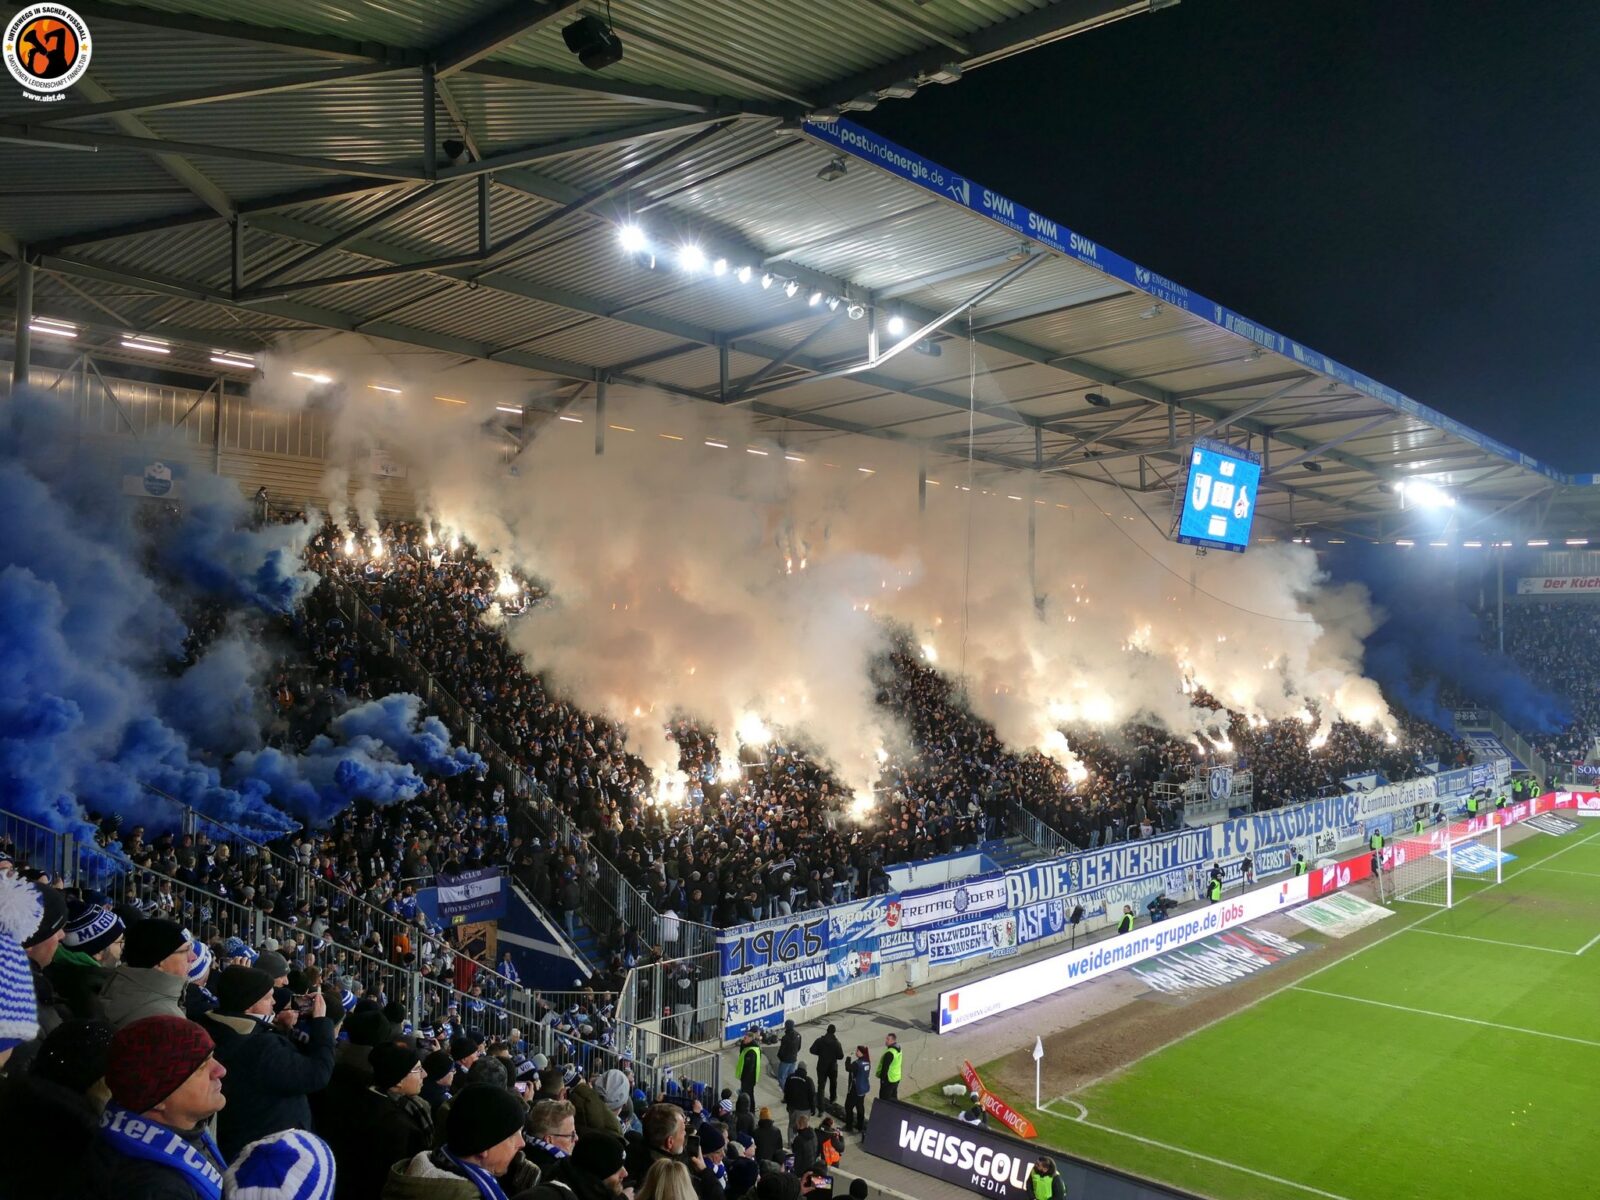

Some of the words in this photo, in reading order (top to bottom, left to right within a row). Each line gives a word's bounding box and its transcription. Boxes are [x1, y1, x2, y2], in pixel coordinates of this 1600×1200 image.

[983, 190, 1015, 220] SWM
[1028, 212, 1058, 241] SWM
[1070, 233, 1097, 260] SWM
[1543, 579, 1567, 589] Der
[1252, 795, 1355, 850] MAGDEBURG
[1006, 862, 1068, 910] BLUE
[1081, 833, 1204, 889] GENERATION
[1262, 849, 1286, 870] ZERBST
[901, 899, 953, 918] FREITAG
[969, 890, 994, 904] DER
[929, 924, 981, 944] SALZWEDEL
[1018, 903, 1047, 943] ASP
[730, 918, 824, 975] 1965
[880, 931, 915, 949] BEZIRK
[930, 937, 981, 958] SEEHAUSEN
[1067, 903, 1244, 978] weidemann-gruppe.de/jobs
[724, 973, 780, 996] FCM-SUPPORTERS
[783, 965, 824, 985] TELTOW
[743, 987, 785, 1015] BERLIN
[983, 1092, 1004, 1115] MDCC
[1003, 1109, 1028, 1133] MDCC
[971, 1173, 1007, 1196] MEDIA
